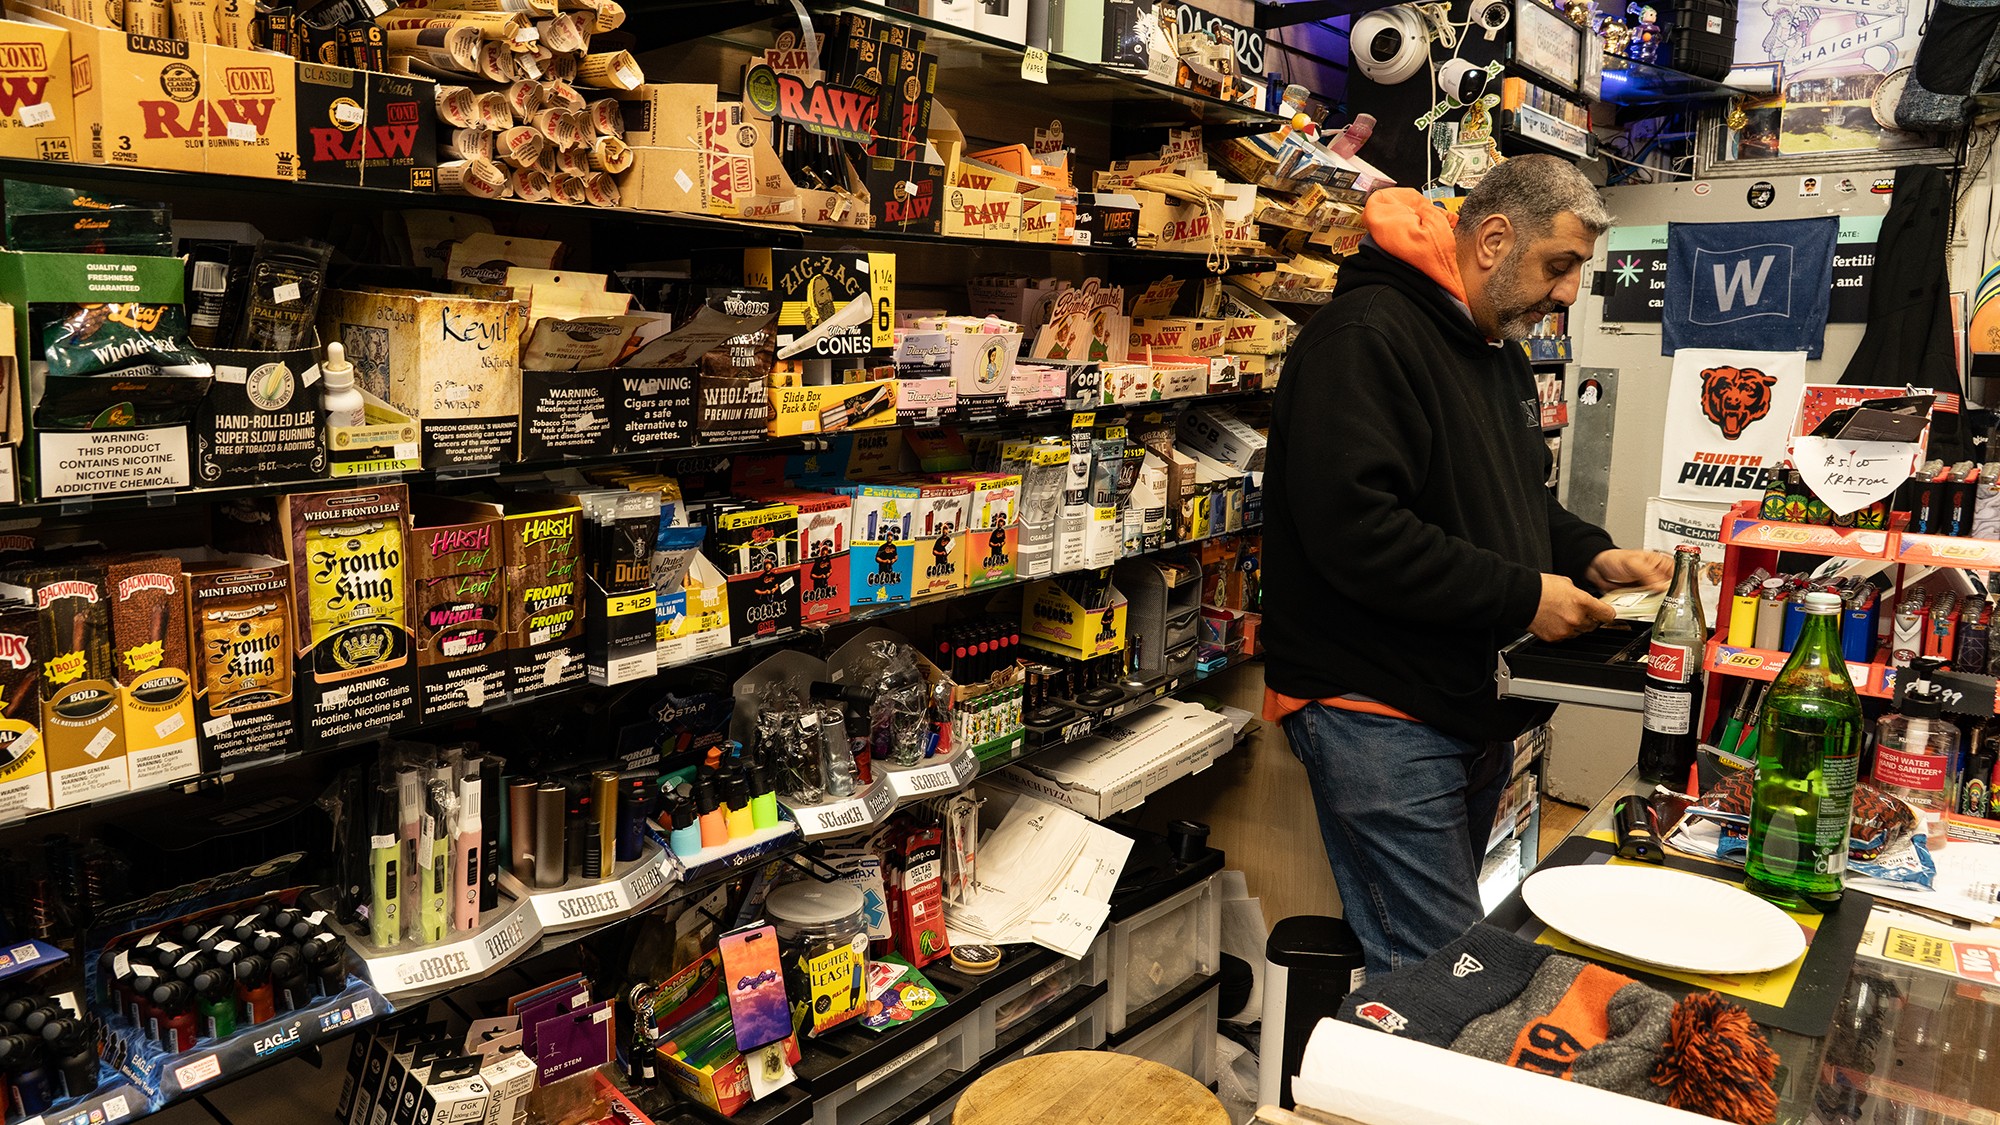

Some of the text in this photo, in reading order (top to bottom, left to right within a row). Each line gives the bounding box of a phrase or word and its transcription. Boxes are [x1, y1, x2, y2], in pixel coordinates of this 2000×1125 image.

[1164, 8, 1176, 17] OCB
[130, 36, 186, 57] CLASSIC
[1802, 27, 1882, 61] HAIGHT
[0, 46, 42, 70] CONE
[1025, 50, 1044, 60] HERB
[304, 68, 351, 84] CLASSIC
[1025, 63, 1044, 74] VAPES
[230, 71, 272, 93] CONE
[378, 78, 413, 97] Black
[854, 77, 878, 96] Black
[389, 105, 417, 122] CONE
[778, 77, 872, 132] RAW
[138, 99, 276, 139] RAW
[1415, 102, 1449, 130] DIME
[118, 136, 132, 151] 3
[208, 138, 270, 149] BURNING PAPERS
[310, 125, 420, 162] RAW
[1461, 130, 1488, 141] RAW
[42, 151, 70, 161] SIZE
[112, 151, 139, 159] CONES
[1035, 141, 1062, 154] RAW
[704, 110, 733, 204] RAW
[734, 159, 750, 190] CONE
[467, 175, 494, 194] RAW
[885, 196, 932, 223] RAW
[963, 202, 1010, 226] RAW
[1104, 212, 1132, 230] VIBES
[86, 264, 137, 272] QUALITY AND
[1832, 255, 1875, 267] fertilit
[87, 274, 134, 282] FRESHNESS
[781, 256, 862, 295] ZIG-ZAG
[1712, 254, 1776, 312] W
[1837, 275, 1863, 287] and
[107, 302, 167, 332] Leaf
[253, 308, 281, 318] PALM
[724, 301, 770, 316] WOODS
[878, 297, 890, 331] 6
[441, 306, 511, 351] Keyif
[816, 336, 871, 355] CONES
[877, 333, 892, 343] PACK
[1140, 332, 1182, 346] RAW
[92, 337, 148, 365] Whole
[481, 356, 513, 371] Natural
[550, 388, 599, 398] WARNING:
[704, 388, 748, 405] WHOLE
[783, 391, 821, 403] Slide Box
[908, 388, 953, 402] Blazy Susan
[624, 397, 690, 411] Cigars are not
[782, 401, 820, 414] Pack & Go!
[215, 411, 316, 429] HAND-ROLLED LEAF
[653, 409, 672, 419] safe
[704, 408, 742, 421] PREMIUM
[458, 423, 491, 431] GENERAL'S
[492, 421, 518, 429] WARNING:
[625, 419, 688, 432] alternative to
[91, 432, 149, 444] WARNING:
[215, 426, 316, 444] SUPER SLOW BURNING
[632, 432, 680, 444] cigarettes.
[77, 443, 161, 457] THIS PRODUCT
[215, 439, 316, 455] FREE OF TOBACCO & ADDITIVES
[59, 454, 175, 470] CONTAINS NICOTINE.
[266, 462, 277, 471] CT.
[347, 459, 407, 474] 5 FILTERS
[1693, 452, 1762, 466] FOURTH
[76, 465, 162, 480] NICOTINE IS AN
[1678, 461, 1770, 490] PHASE
[1824, 474, 1889, 487] KRATOM
[55, 476, 180, 494] ADDICTIVE CHEMICAL.
[304, 503, 400, 521] WHOLE FRONTO LEAF
[522, 515, 573, 543] HARSH
[1660, 521, 1720, 540] NFC CHAMP
[431, 525, 490, 555] HARSH
[312, 545, 400, 585] Fronto
[653, 562, 684, 574] Masters
[662, 556, 684, 565] Dutch
[119, 574, 175, 601] BACKWOODS
[199, 579, 287, 598] MINI FRONTO LEAF
[328, 574, 395, 610] King
[457, 574, 496, 597] Leaf
[524, 582, 573, 601] FRONTO
[38, 581, 98, 609] BACKWOODS
[549, 596, 567, 606] LEAF
[616, 597, 651, 612] 2 $1.29
[430, 608, 483, 626] WHOLE
[530, 610, 574, 628] FRONTO
[208, 633, 280, 665] Fronto
[1729, 655, 1760, 666] BIC
[220, 655, 275, 685] King
[447, 664, 488, 678] WARNING:
[142, 677, 180, 690] ORIGINAL
[339, 678, 389, 694] WARNING:
[70, 691, 98, 702] BOLD
[233, 714, 274, 727] WARNING:
[312, 697, 413, 727] nicotine. Nicotine is an
[321, 710, 405, 738] addictive chemical.
[1880, 751, 1930, 768] FRESH WATER
[1880, 760, 1942, 776] HAND SANITIZER+
[911, 770, 952, 791] SCORCH
[1009, 776, 1073, 805] BEACH PIZZA
[818, 806, 864, 829] SCORCH
[909, 849, 935, 862] hemp.co
[631, 867, 660, 899] TORCH
[557, 891, 618, 919] SCORCH
[485, 918, 522, 960] TORCH
[811, 951, 849, 973] LIGHTER
[812, 964, 850, 988] LEASH
[254, 1026, 299, 1054] EAGLE
[544, 1057, 582, 1075] DART STEM
[871, 1044, 926, 1080] DROP DOWN ADAPTERS
[461, 1102, 477, 1110] OGK
